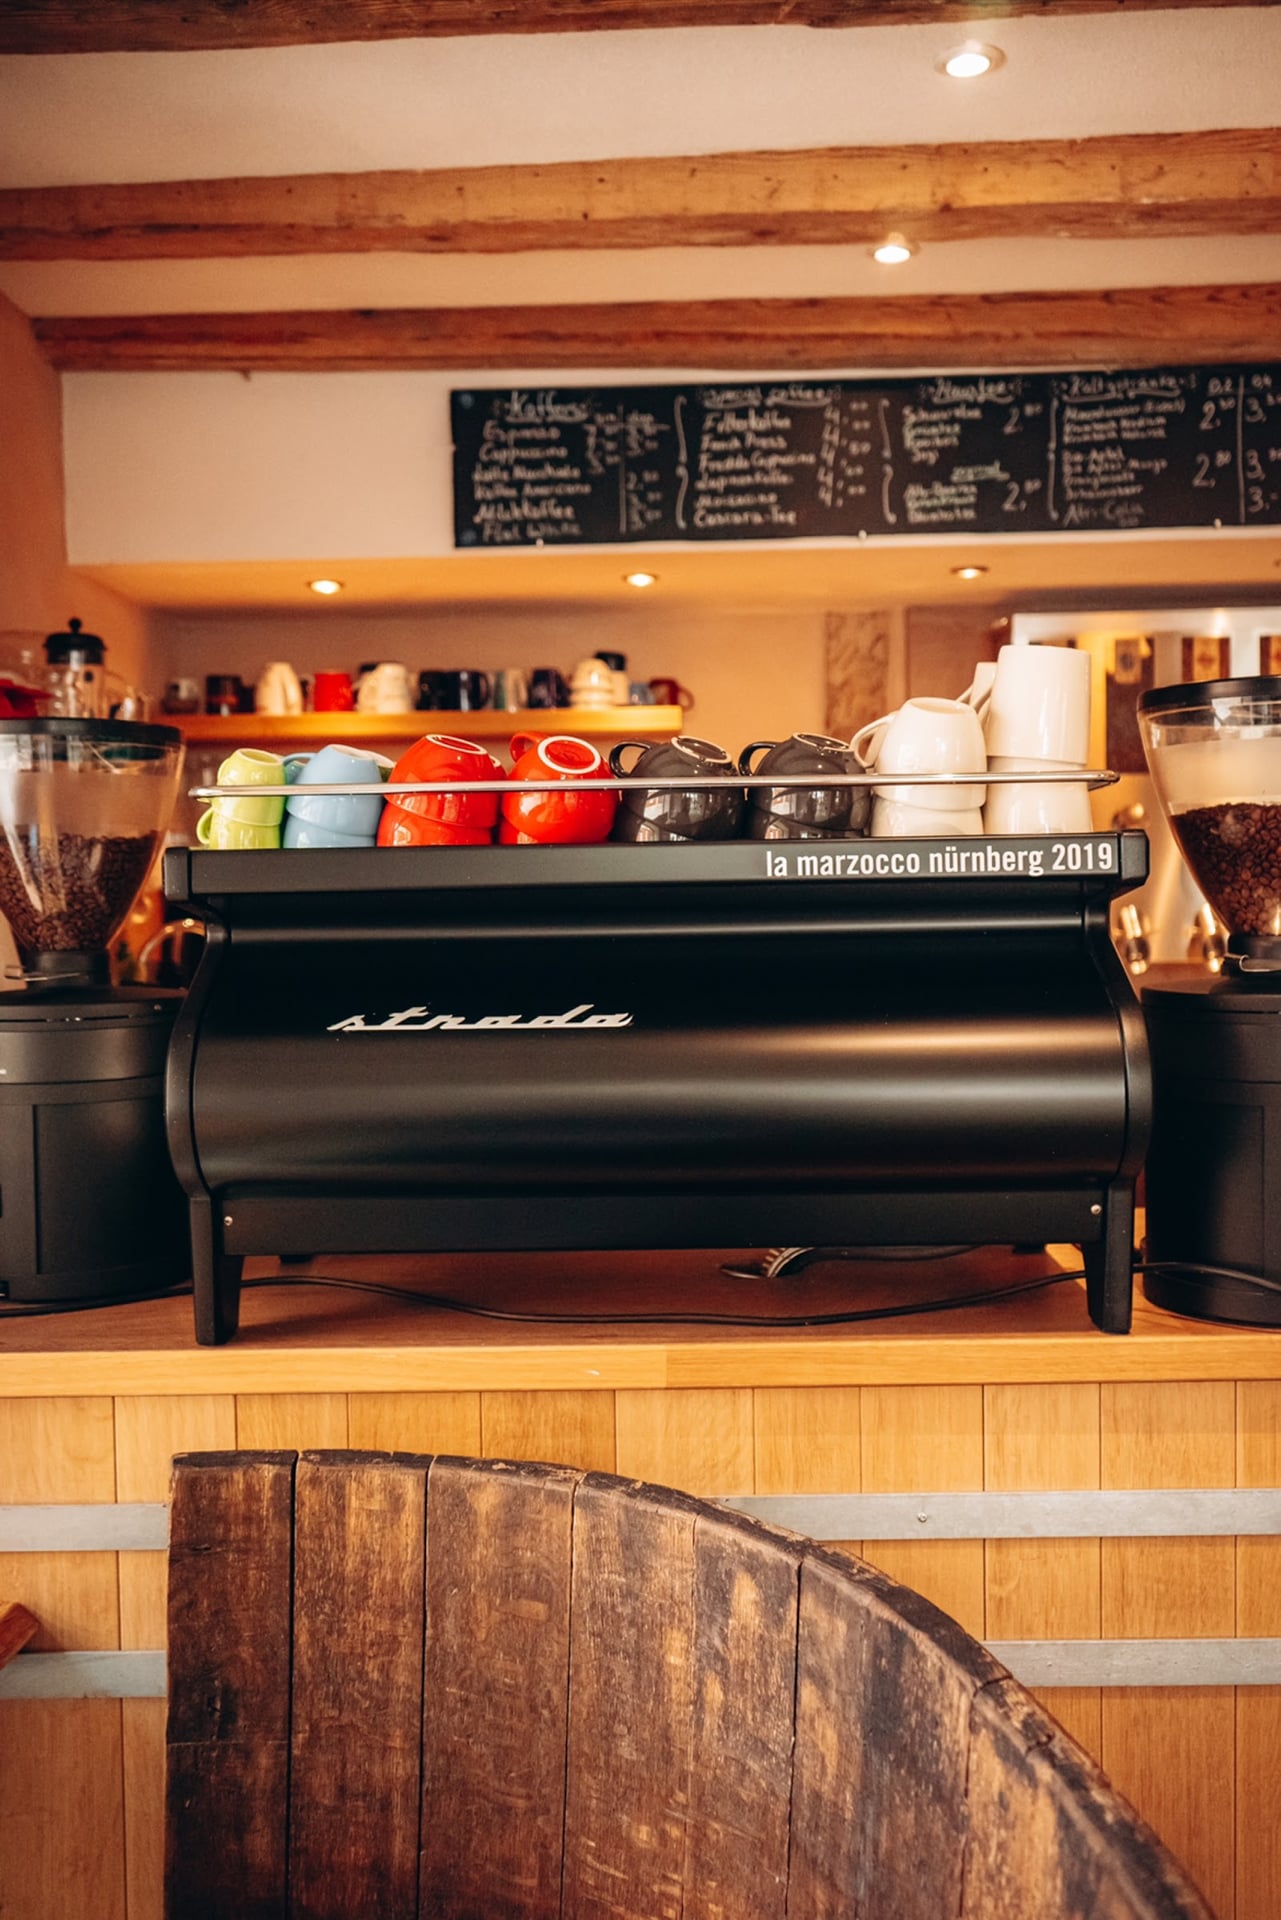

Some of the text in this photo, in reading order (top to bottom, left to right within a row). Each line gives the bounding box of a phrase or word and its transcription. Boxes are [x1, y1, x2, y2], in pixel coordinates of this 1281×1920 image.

[766, 843, 1113, 877] la marzocco nürnberg 2019
[326, 1004, 634, 1032] strada
